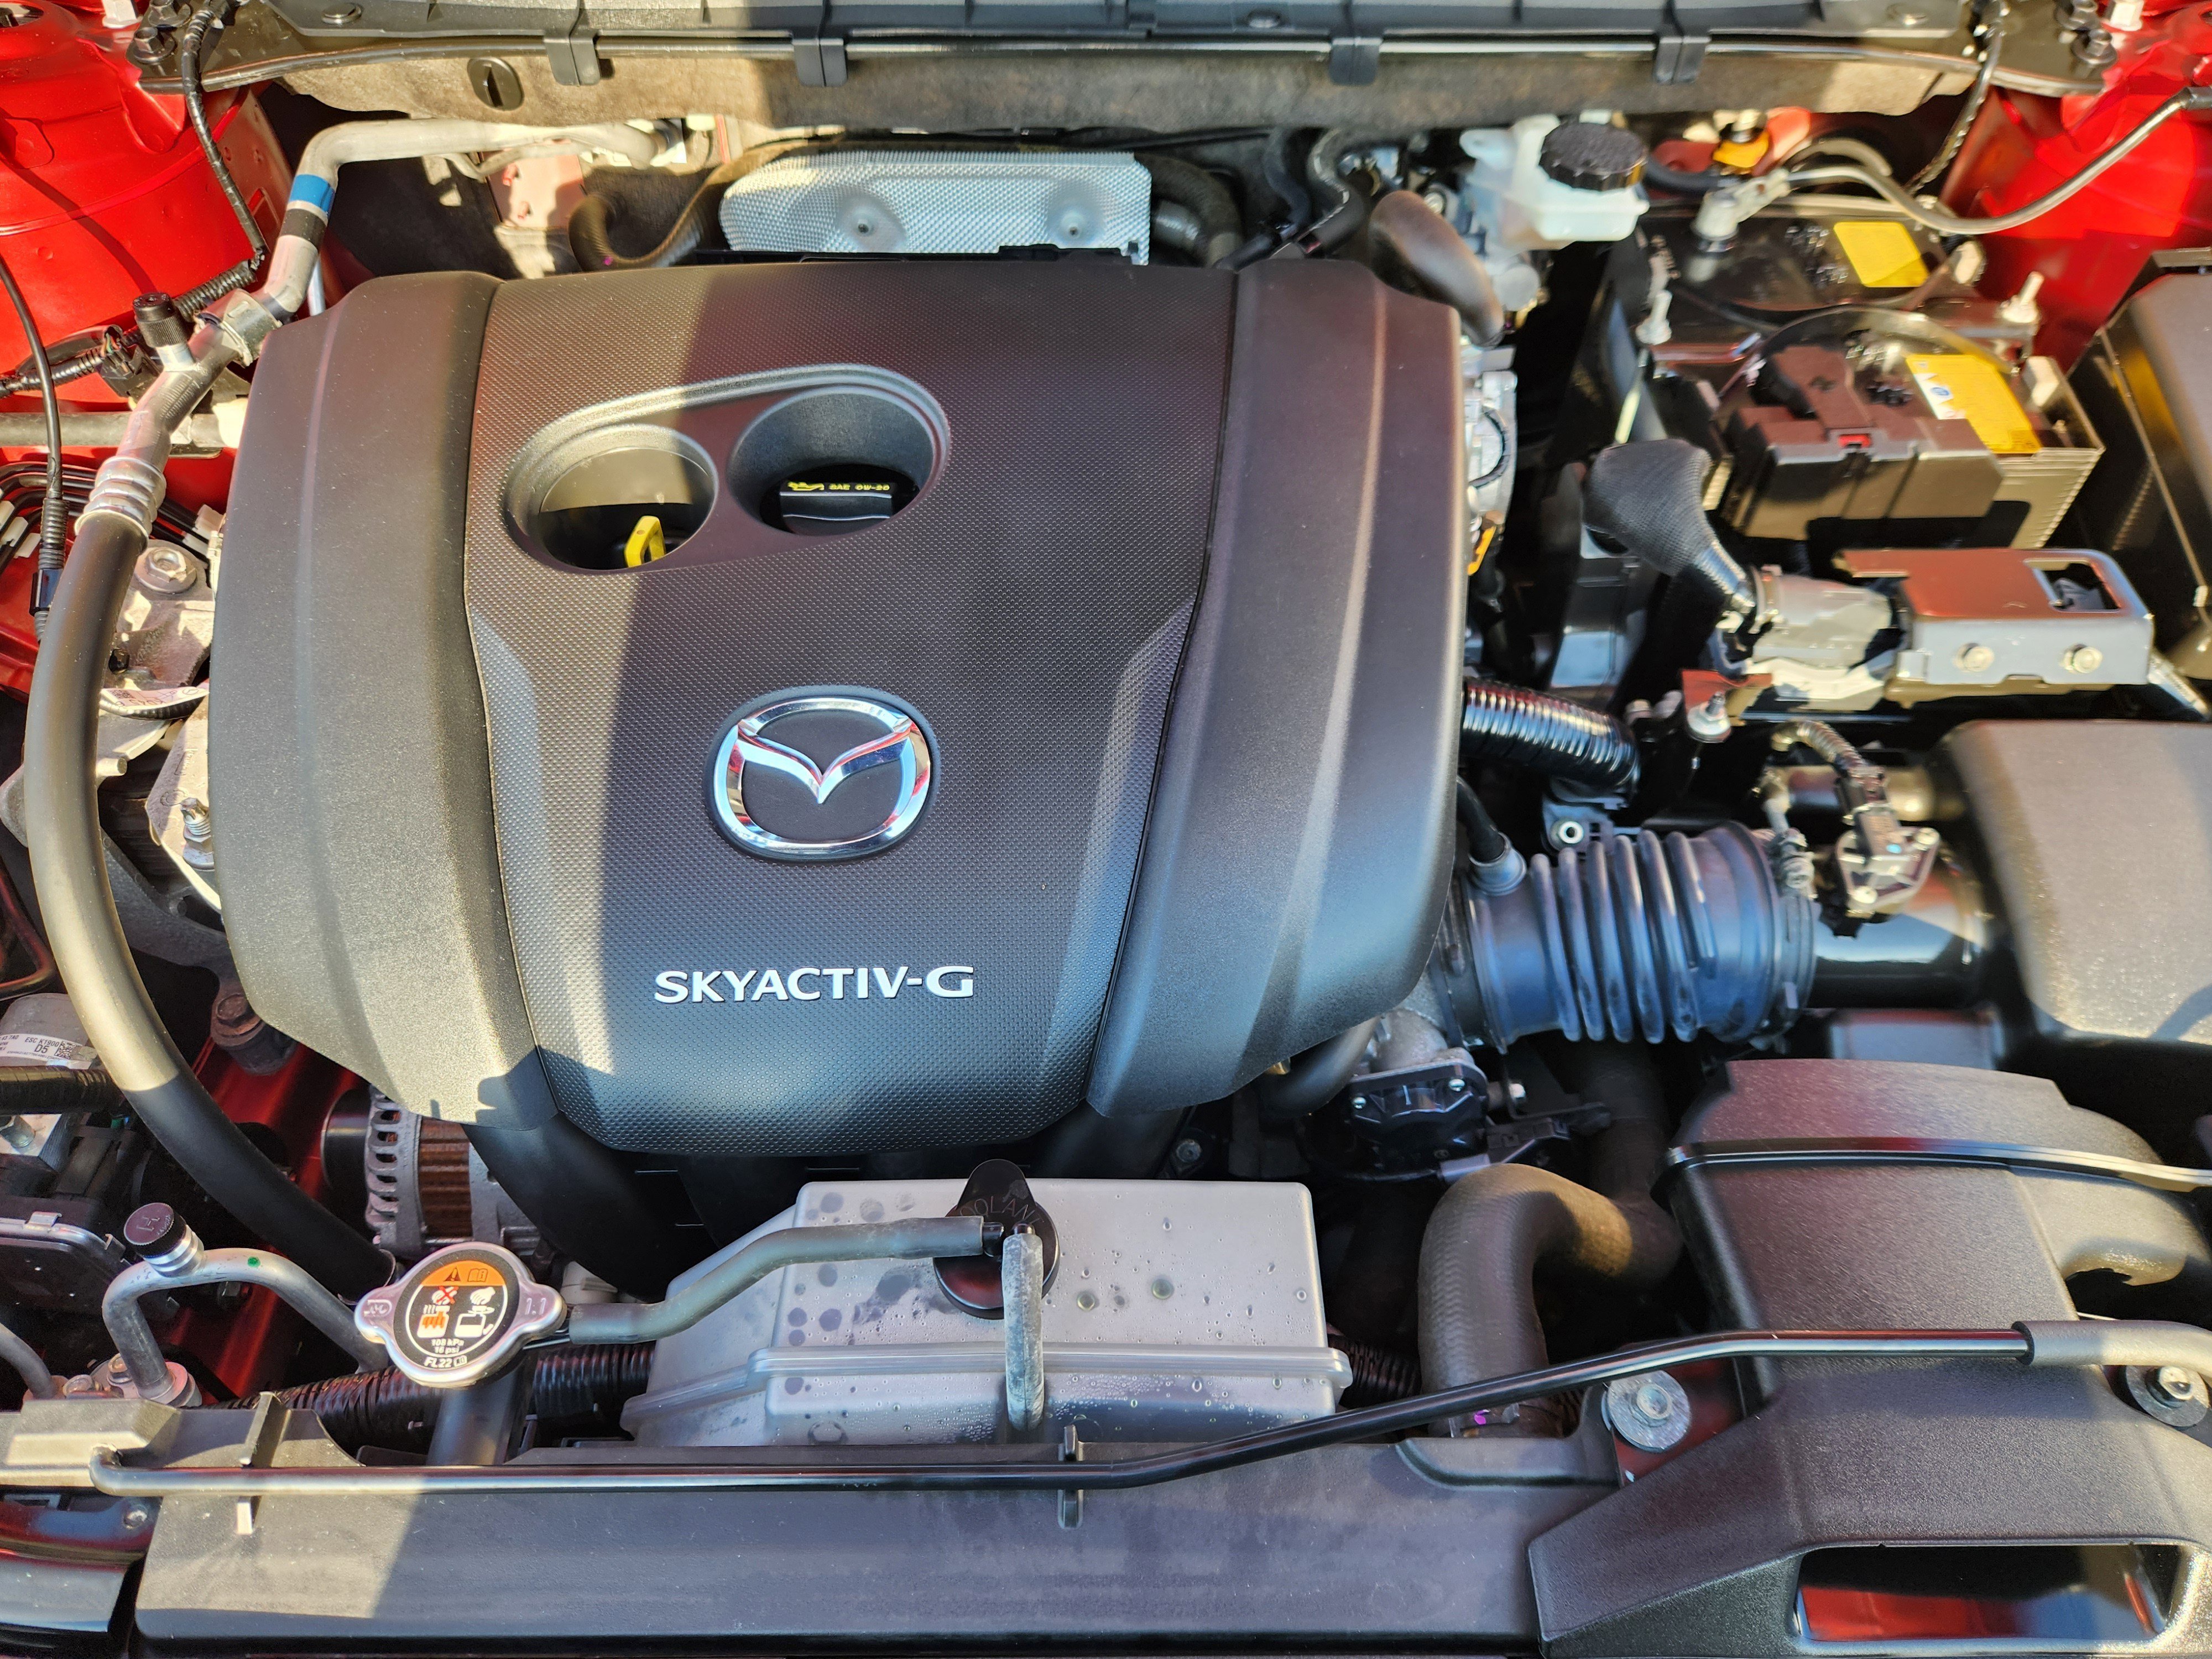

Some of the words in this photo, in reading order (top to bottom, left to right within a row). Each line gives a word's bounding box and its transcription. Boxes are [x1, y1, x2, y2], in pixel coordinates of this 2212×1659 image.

[655, 966, 974, 1003] SKYACTIV-G
[38, 1039, 60, 1047] K1900
[34, 1044, 49, 1053] D5
[445, 1345, 460, 1354] psi
[424, 1356, 452, 1368] FL22
